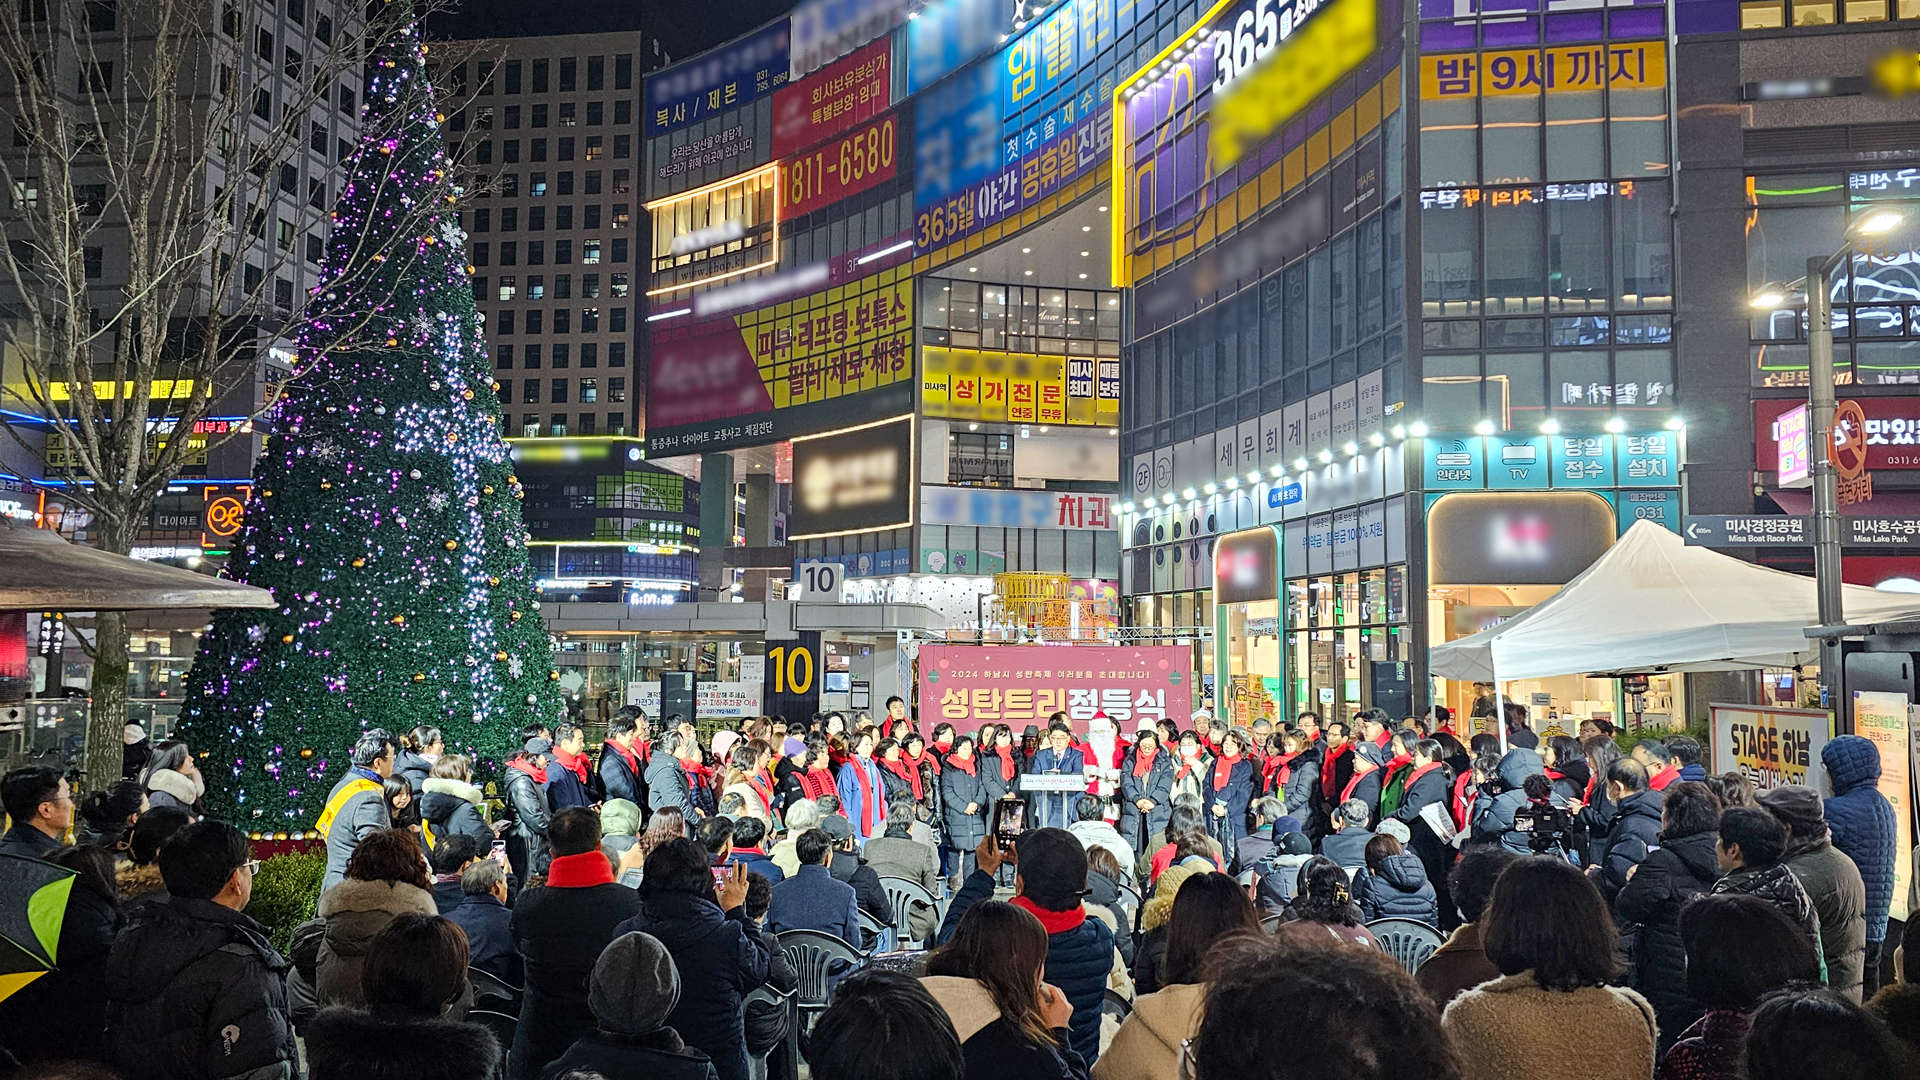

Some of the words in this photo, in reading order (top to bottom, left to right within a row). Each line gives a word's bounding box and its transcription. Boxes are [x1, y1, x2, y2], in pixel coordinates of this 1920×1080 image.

[1437, 58, 1476, 95] 밤
[1490, 54, 1555, 90] 9시
[1566, 48, 1645, 86] 까지
[656, 102, 686, 127] 복사
[707, 82, 737, 111] 제본
[659, 161, 687, 177] 해드리기
[688, 156, 702, 170] 위해
[725, 138, 753, 158] 있습니다
[781, 119, 894, 208] 1811-6580
[917, 190, 975, 248] 365일
[978, 168, 1018, 219] 야간
[847, 257, 860, 273] 3F
[1069, 361, 1092, 377] 미사
[925, 382, 947, 392] 미사역
[1069, 381, 1092, 397] 최대
[1011, 407, 1033, 419] 연중
[1041, 409, 1062, 420] 무휴
[651, 434, 679, 451] 통증추나
[682, 431, 710, 447] 다이어트
[714, 426, 741, 441] 교통사고
[745, 420, 773, 435] 체질진단
[1865, 418, 1920, 445] 맛있
[1564, 438, 1604, 457] 당일
[1627, 436, 1667, 455] 당일
[1437, 469, 1471, 482] 인터넷
[1510, 469, 1528, 480] TV
[1564, 460, 1604, 479] 접수
[1628, 459, 1668, 478] 설치
[1138, 470, 1149, 486] 2F
[159, 516, 198, 526] 다이어트
[1634, 507, 1665, 519] 031
[1369, 521, 1383, 538] 지원
[1726, 519, 1803, 534] 미사경정공원
[880, 560, 891, 568] DOG
[894, 559, 909, 567] MARU
[805, 566, 834, 593] 10
[769, 647, 813, 694] 10
[951, 670, 978, 679] 2024
[984, 670, 1010, 679] 하남시
[1016, 670, 1052, 679] 성탄축제
[1057, 671, 1093, 679] 여러분을
[1098, 670, 1150, 679] 초대합니다!
[1731, 723, 1779, 763] STAGE
[1783, 728, 1811, 767] 하남
